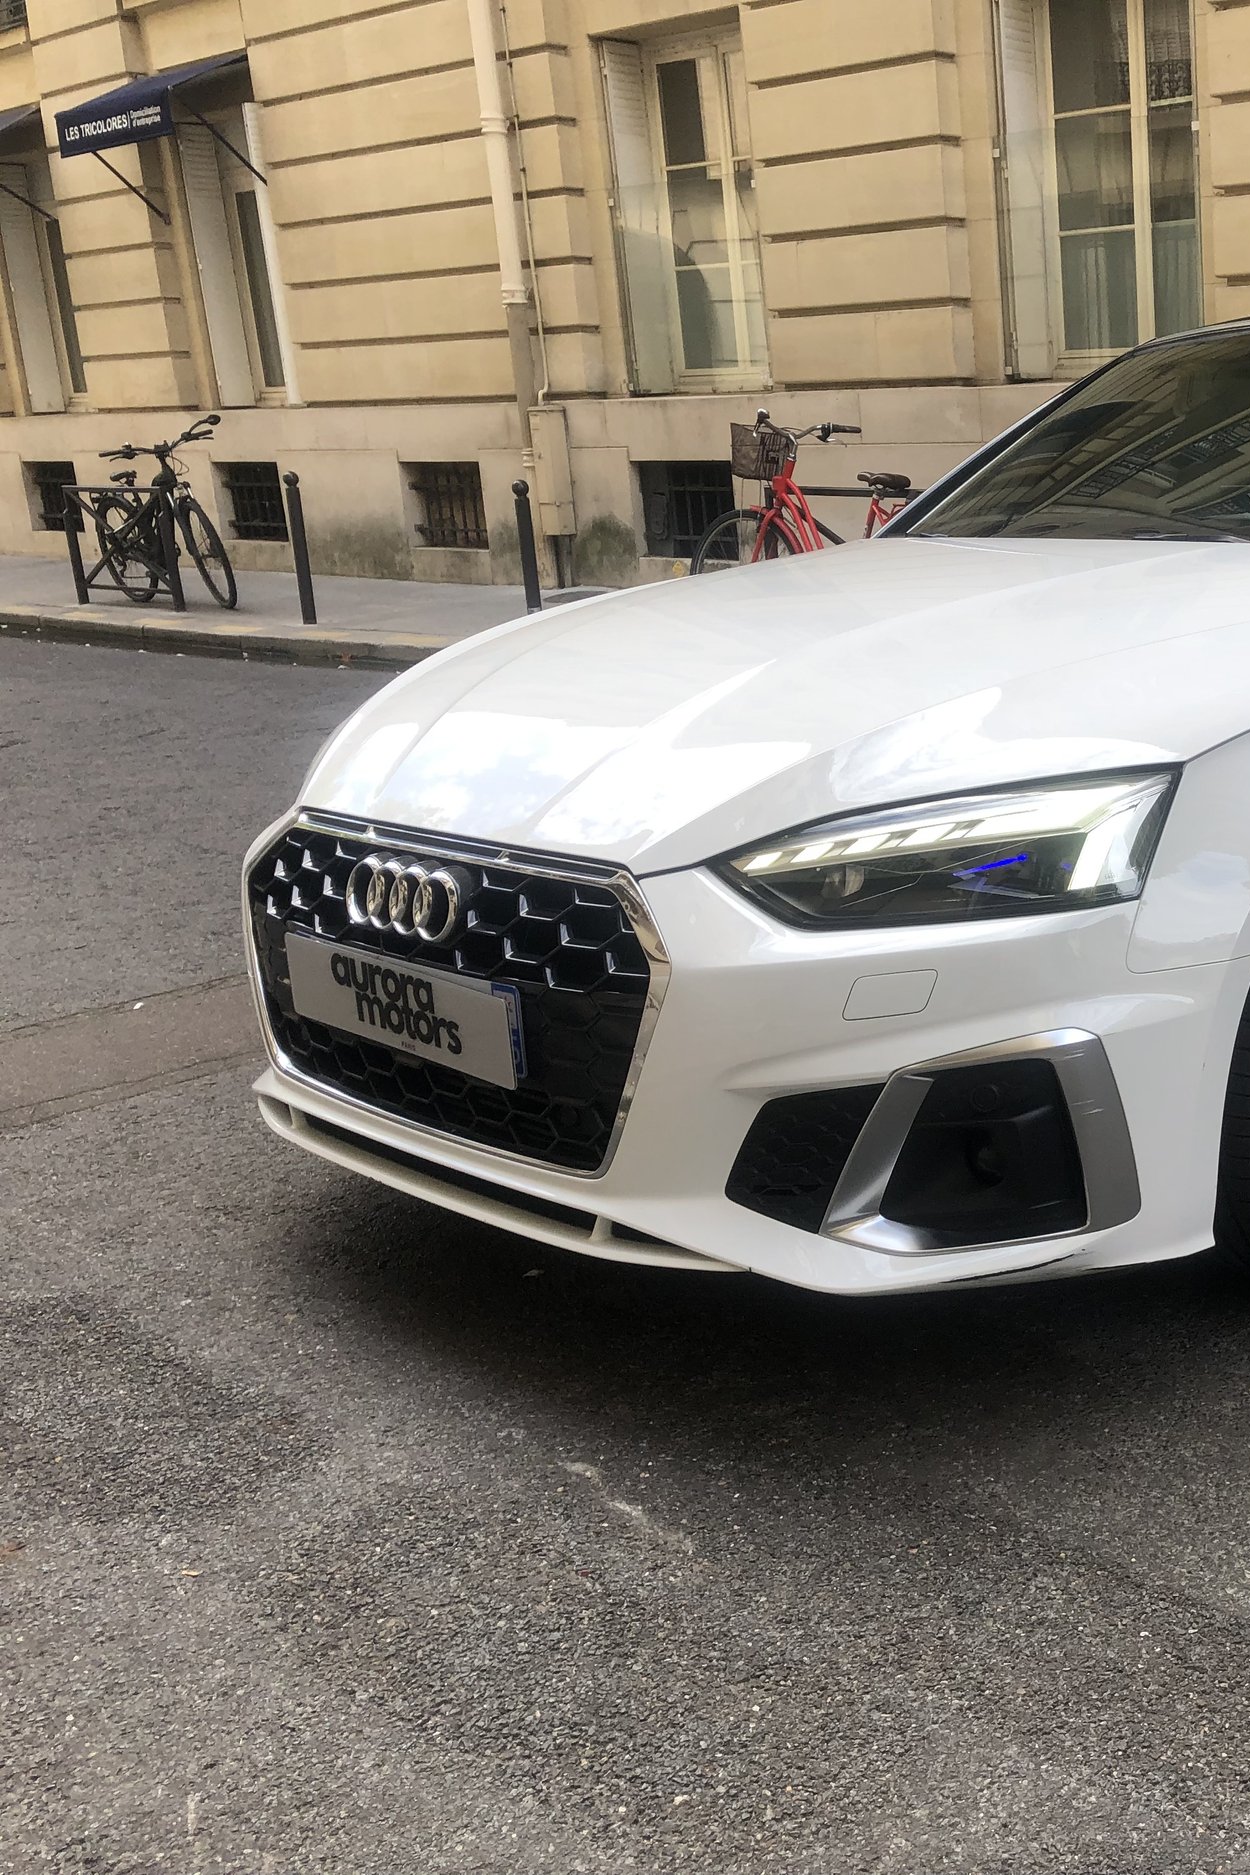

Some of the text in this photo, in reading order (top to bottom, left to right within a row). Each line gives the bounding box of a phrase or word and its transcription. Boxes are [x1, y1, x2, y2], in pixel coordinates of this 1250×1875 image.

[65, 114, 128, 141] LES TRICOLORES
[330, 952, 435, 1014] aurora
[355, 991, 462, 1055] motors
